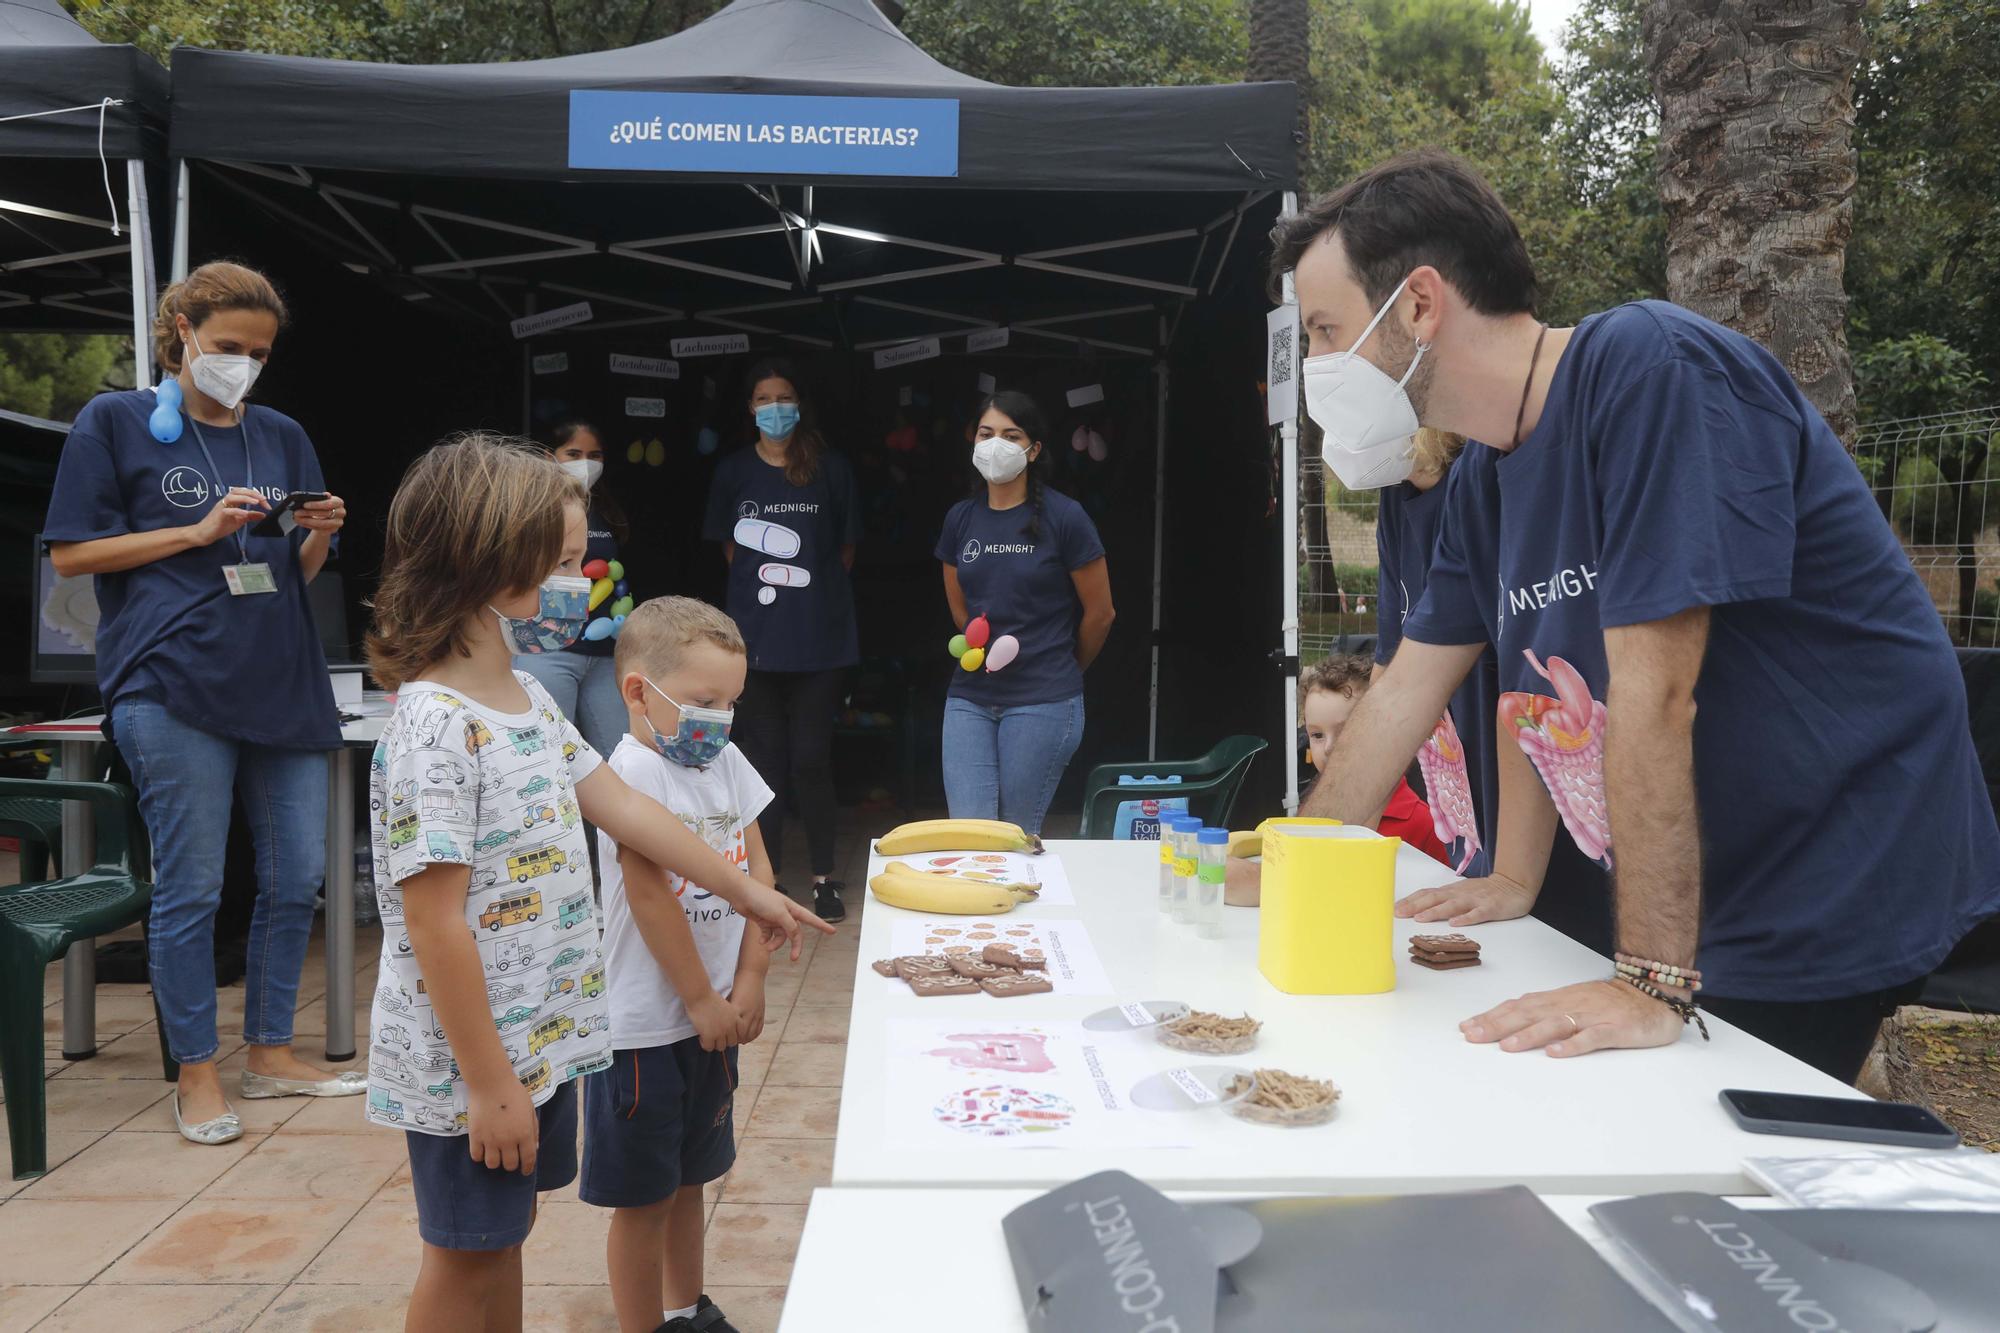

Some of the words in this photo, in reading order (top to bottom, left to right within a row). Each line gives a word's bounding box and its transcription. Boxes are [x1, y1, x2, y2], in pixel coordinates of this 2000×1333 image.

[609, 117, 663, 144] ¿QUÉ
[667, 122, 741, 144] COMEN
[746, 124, 786, 145] LAS
[789, 125, 920, 147] BACTERIAS?
[516, 310, 589, 335] Ruminococcus
[676, 338, 746, 355] Lachnospira
[883, 344, 931, 363] Salmonella
[611, 356, 679, 376] Lactobacillus
[763, 503, 820, 514] MEDNIGHT
[587, 530, 613, 539] DNIGHT
[984, 544, 1037, 554] MEDNIGHT
[1133, 820, 1161, 834] Fon
[1695, 1218, 1848, 1333] ONNECT
